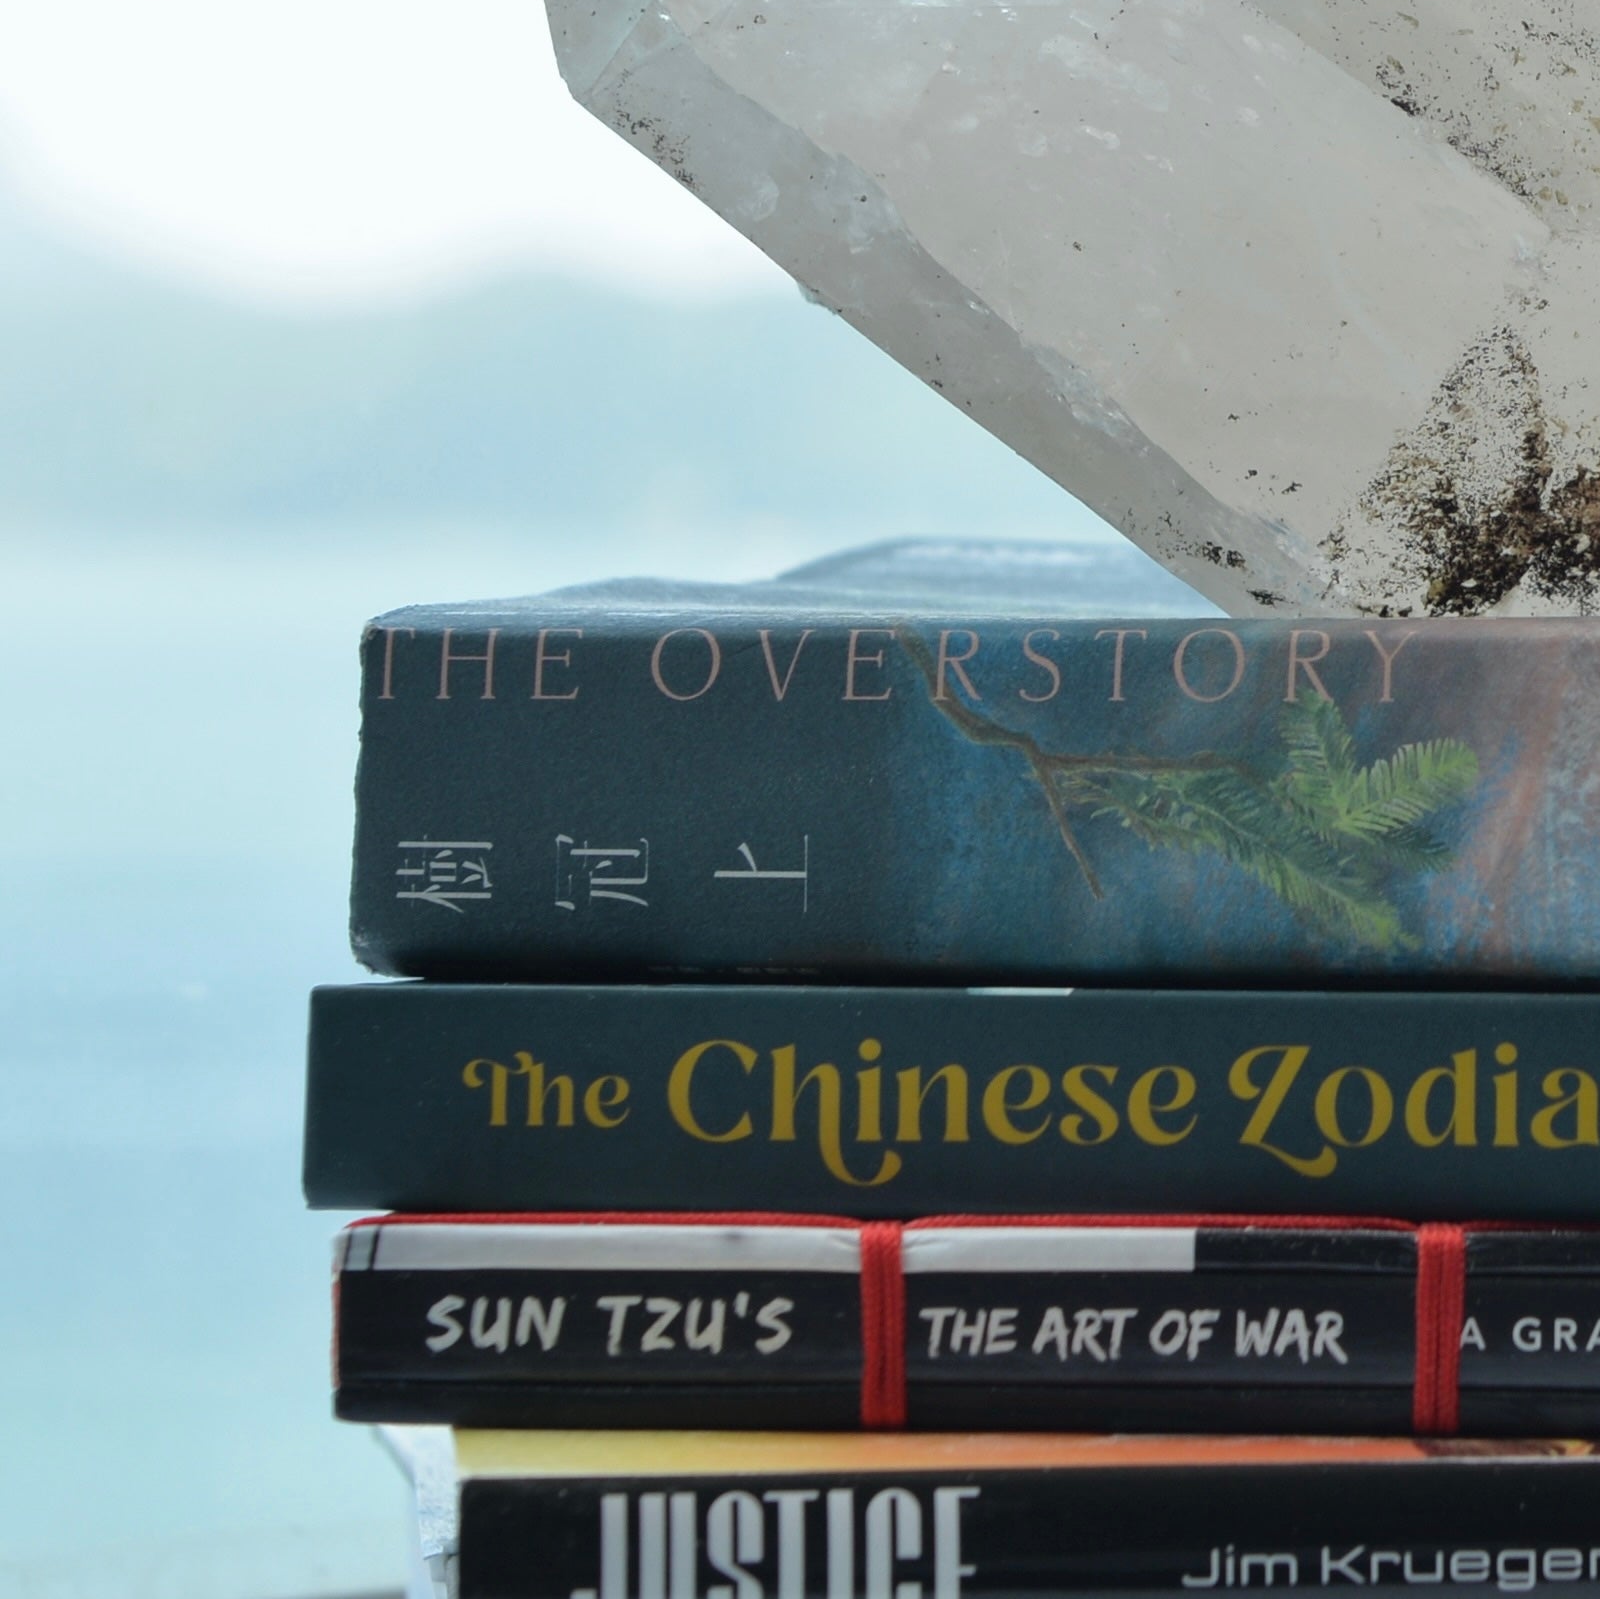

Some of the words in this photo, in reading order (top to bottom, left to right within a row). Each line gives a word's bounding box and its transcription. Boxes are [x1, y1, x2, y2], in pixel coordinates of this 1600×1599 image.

[376, 627, 584, 700] THE
[650, 627, 1419, 702] OVERSTORY
[396, 834, 808, 913] 樹冠上
[461, 1050, 631, 1129] The
[667, 1038, 1198, 1186] Chinese
[425, 1295, 566, 1352] SUN
[597, 1292, 795, 1355] TZU'S
[919, 1307, 1017, 1359] THE
[1031, 1307, 1137, 1361] ART
[1148, 1309, 1220, 1362] OF
[1234, 1309, 1349, 1363] WAR
[1458, 1318, 1486, 1349] A
[570, 1486, 981, 1599] JUSTICE
[1181, 1544, 1298, 1589] Jim
